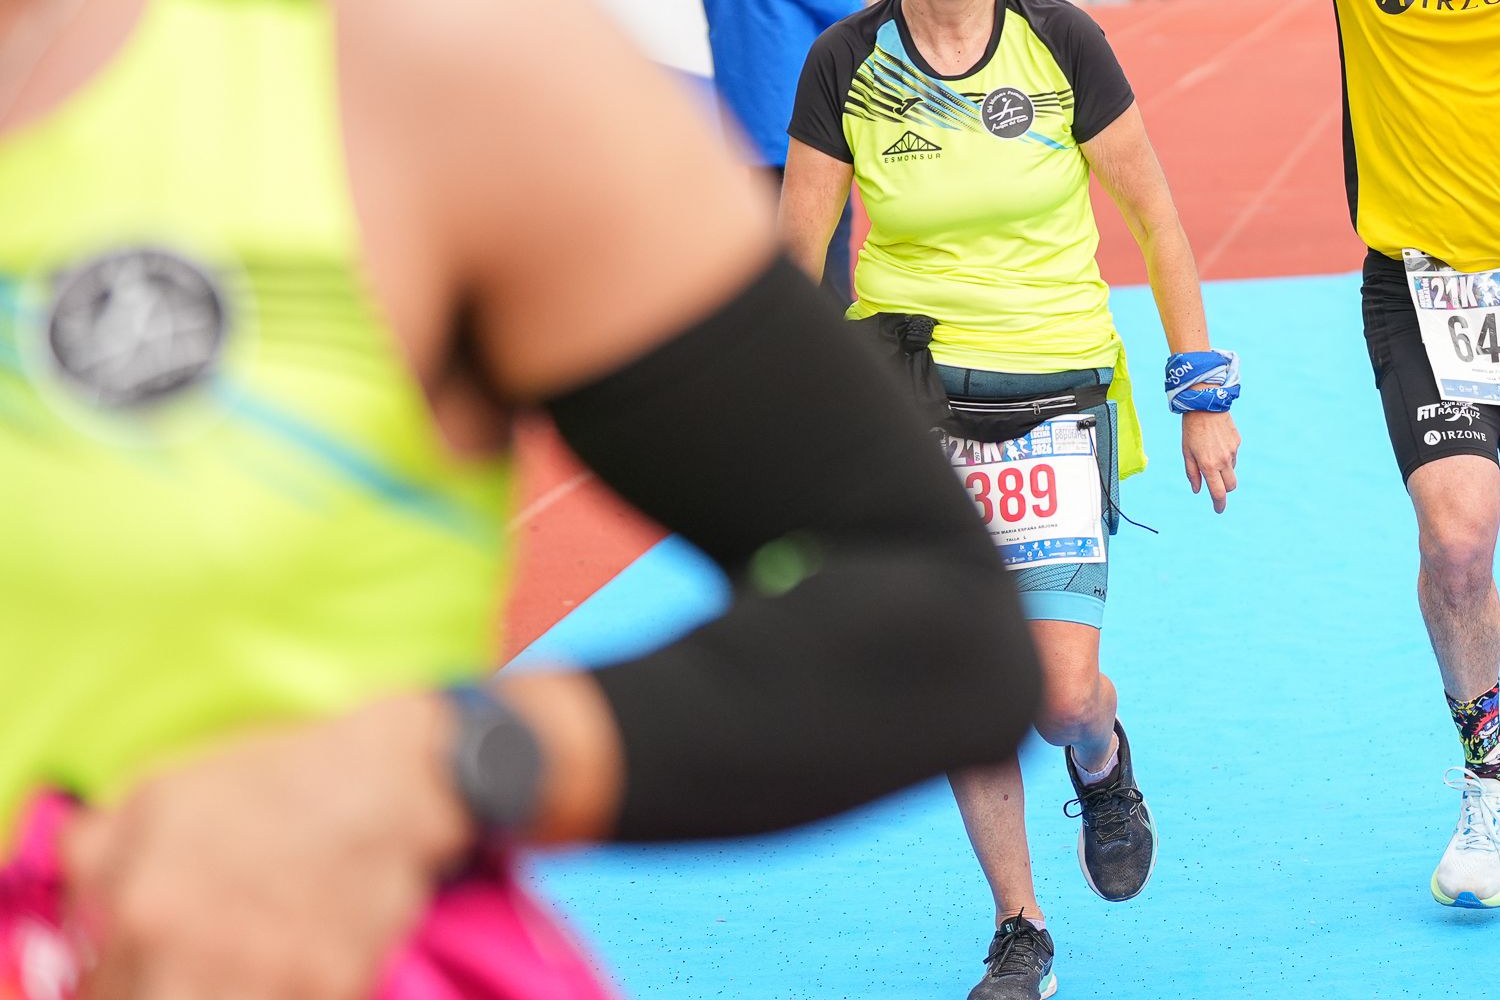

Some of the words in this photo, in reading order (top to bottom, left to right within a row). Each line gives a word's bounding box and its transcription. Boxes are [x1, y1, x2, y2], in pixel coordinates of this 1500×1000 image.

[884, 152, 941, 163] ESMONSUR
[1431, 275, 1478, 308] 21K
[1424, 430, 1487, 446] AIRZONE
[965, 464, 1058, 526] 389
